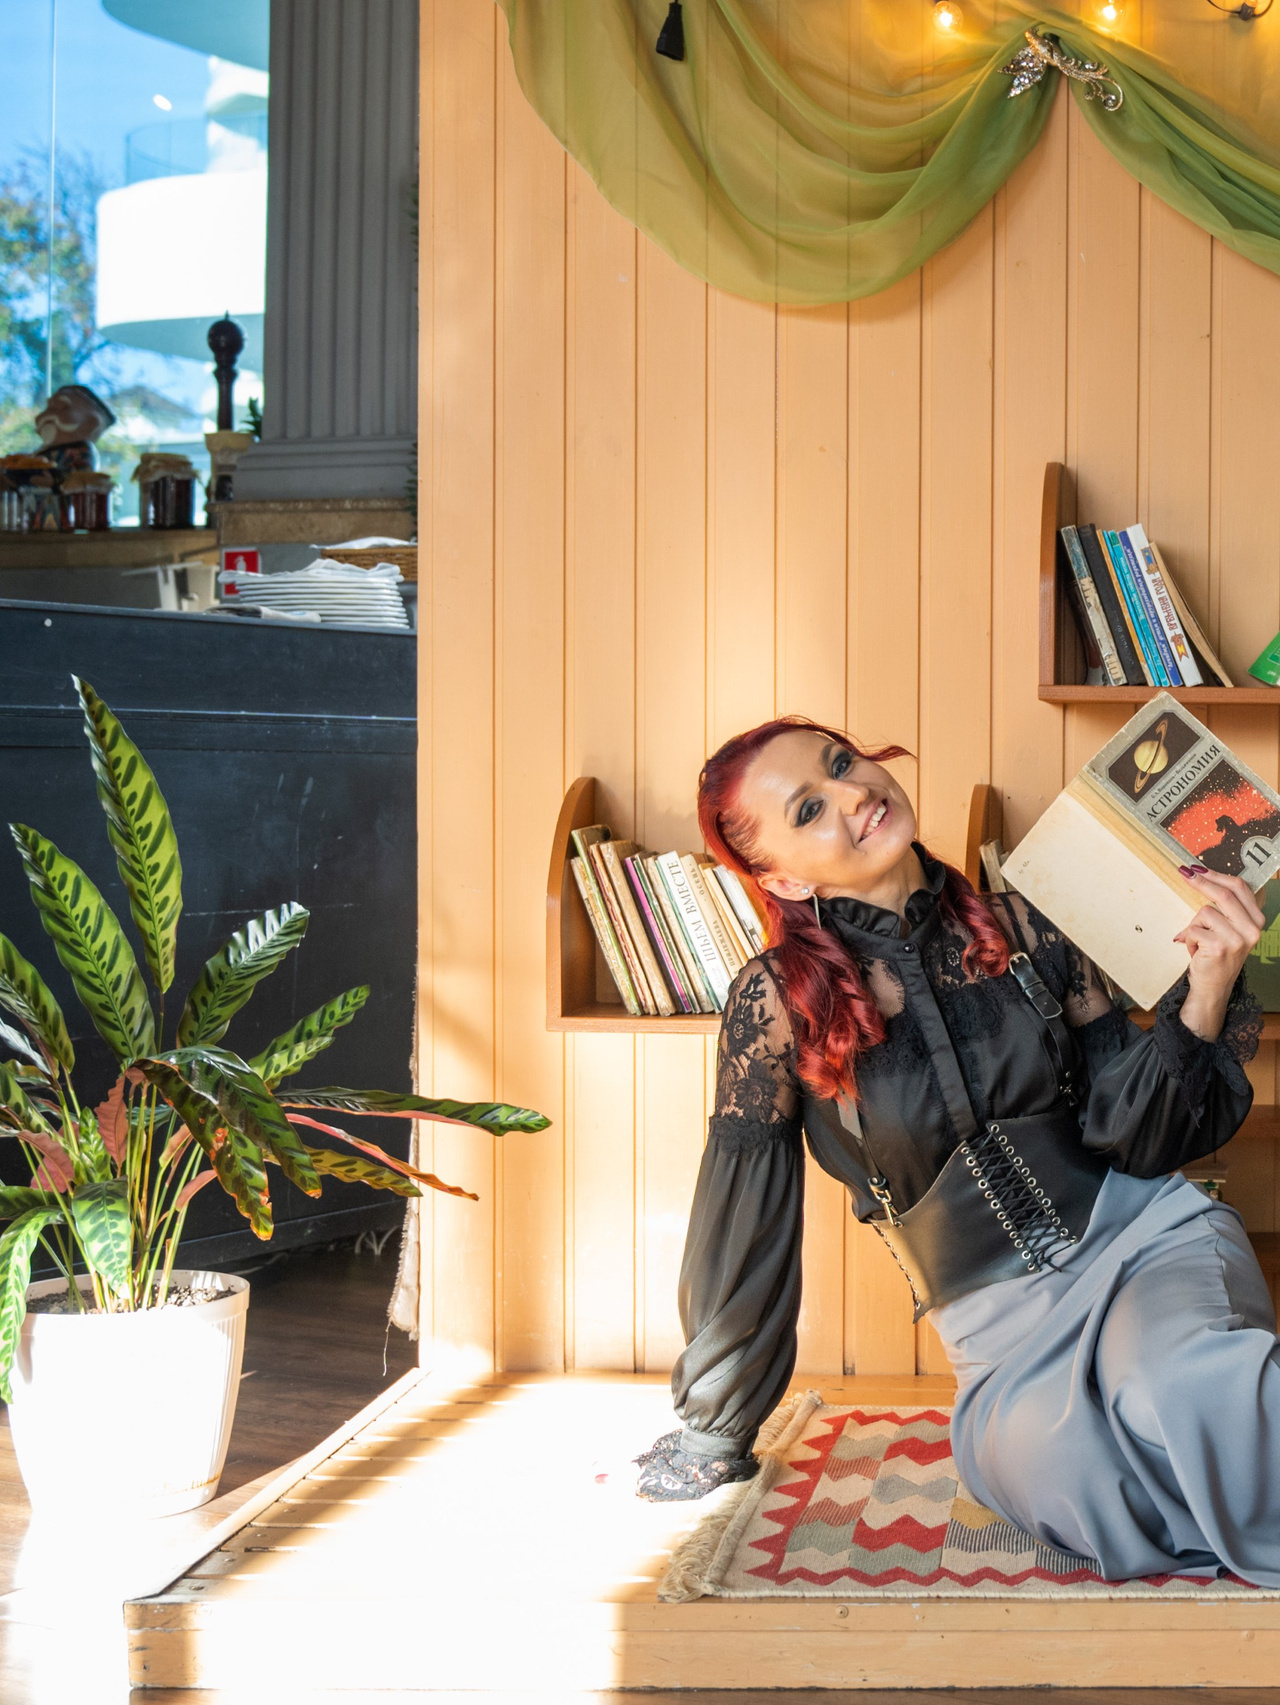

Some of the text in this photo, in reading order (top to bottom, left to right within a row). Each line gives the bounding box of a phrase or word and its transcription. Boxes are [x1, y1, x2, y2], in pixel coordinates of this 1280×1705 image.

[1156, 594, 1178, 631] ВРЕМЕНА
[1143, 743, 1221, 821] АСТРОНОМИЯ
[1244, 841, 1273, 869] 11
[665, 858, 698, 915] ВМЕСТЕ
[689, 867, 705, 895] ОСЕНЬ
[690, 918, 717, 963] ШЬЕМ
[711, 920, 735, 966] ПРИЛЕЖАЕВА
